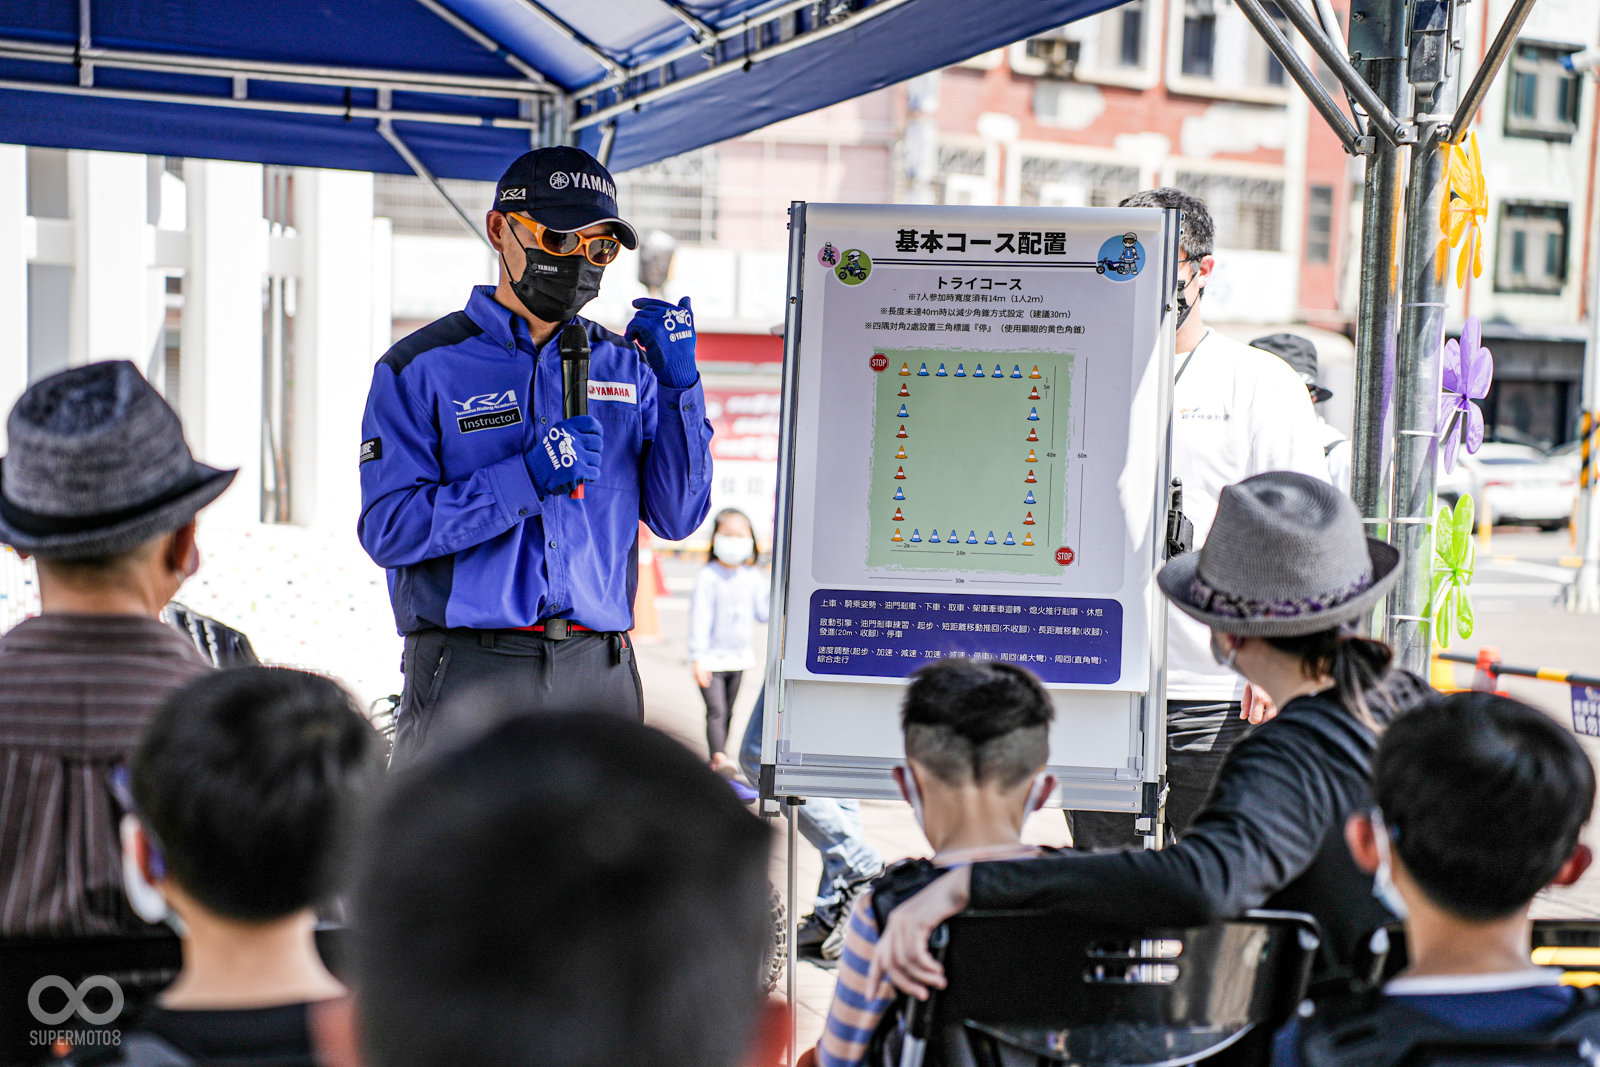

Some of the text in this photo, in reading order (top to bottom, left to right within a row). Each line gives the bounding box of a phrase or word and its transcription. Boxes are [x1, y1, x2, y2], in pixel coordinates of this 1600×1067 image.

[895, 229, 1066, 255] 基本コース配置
[537, 264, 558, 273] YAMAHA
[937, 276, 1022, 291] トライコース
[872, 358, 887, 367] STOP
[595, 386, 630, 398] YAMAHA
[452, 389, 517, 411] YRA
[455, 408, 477, 416] Yamaha
[493, 401, 518, 410] Academy
[463, 412, 516, 430] Instructor
[543, 440, 562, 470] YAMAHA
[1056, 551, 1073, 561] STOP
[816, 654, 850, 664] 綜合走行
